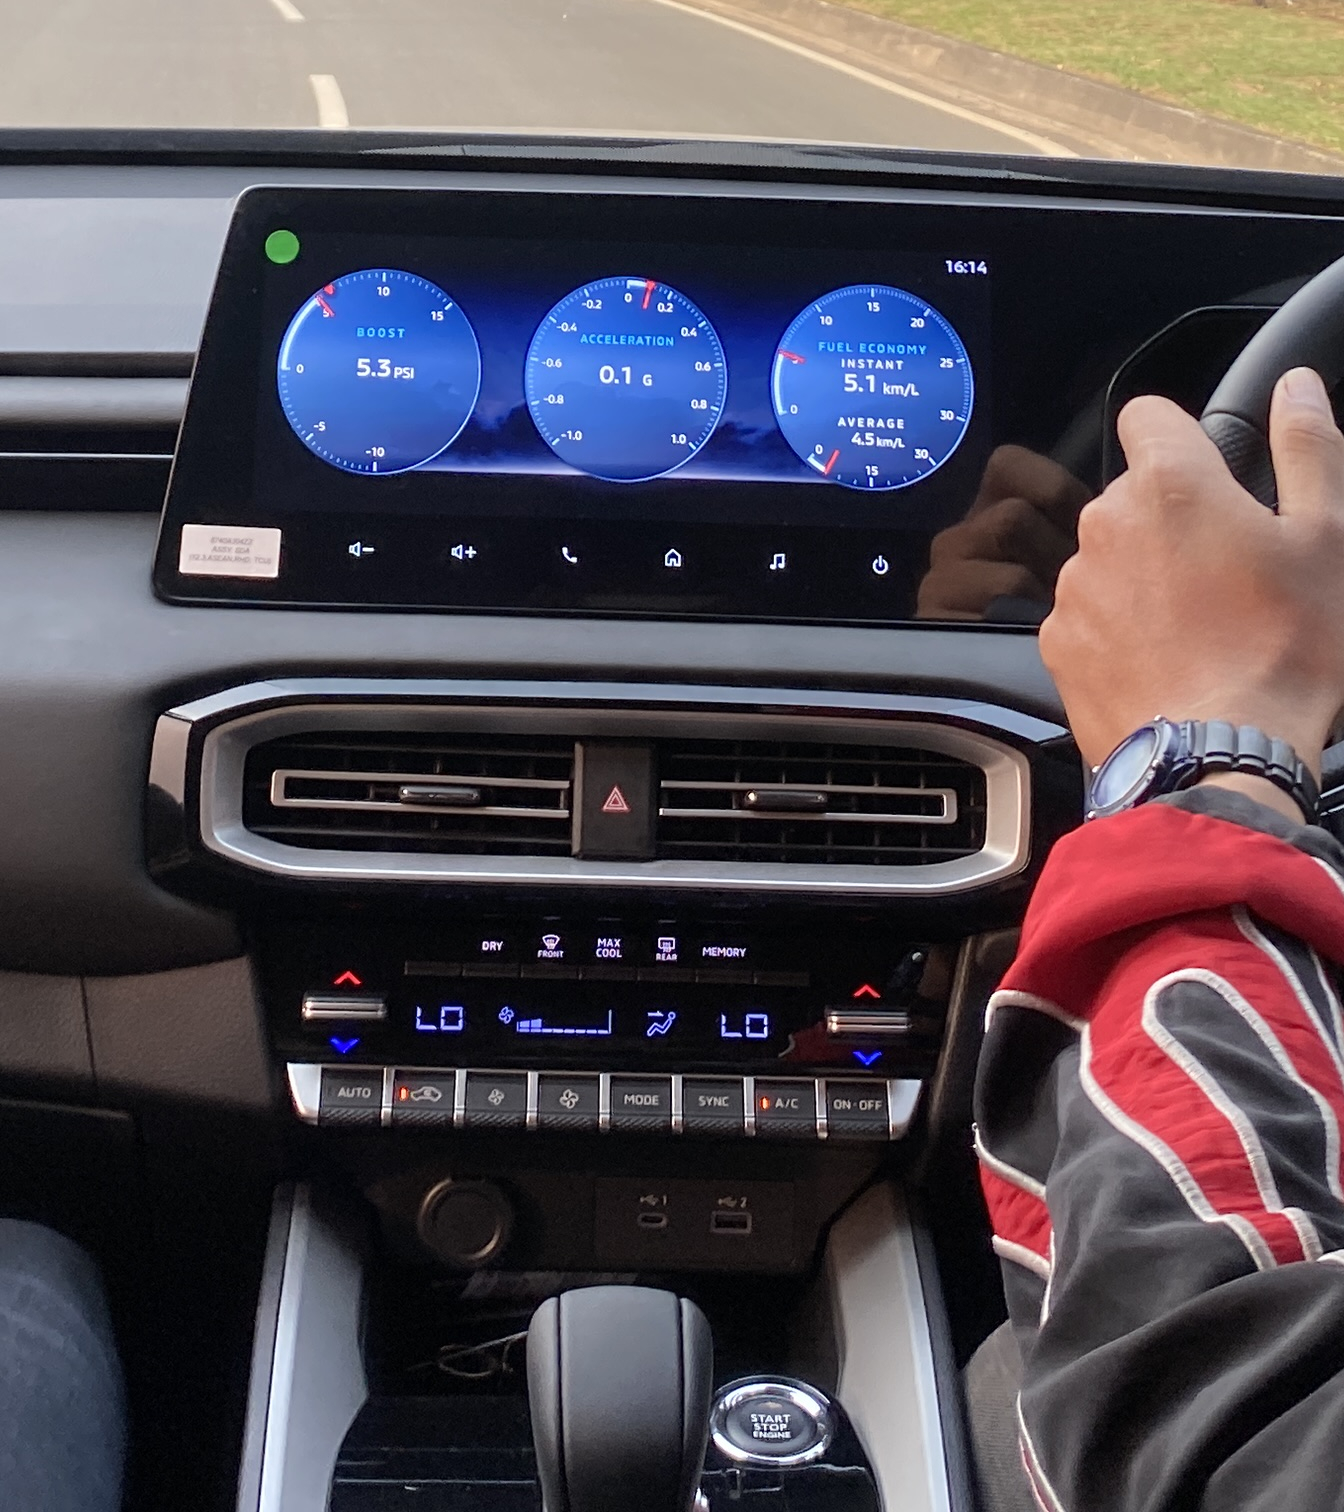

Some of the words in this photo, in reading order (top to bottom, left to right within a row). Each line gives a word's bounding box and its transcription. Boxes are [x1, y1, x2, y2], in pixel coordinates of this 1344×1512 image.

[945, 259, 988, 275] 16:14
[377, 286, 390, 296] 10
[624, 293, 632, 303] 0
[582, 300, 602, 309] -0.2
[657, 303, 674, 313] 0.2
[867, 302, 880, 312] 15
[430, 310, 444, 321] 15
[819, 316, 833, 325] 10
[557, 322, 577, 332] -0.4
[910, 318, 925, 328] 20
[356, 327, 406, 338] BOOST
[680, 327, 698, 337] 0.4
[580, 334, 674, 347] ACCELERATION
[818, 341, 853, 352] FUEL
[859, 343, 927, 355] ECONOMY
[296, 363, 304, 373] 0
[541, 358, 562, 368] -0.6
[694, 362, 711, 371] 0.6
[841, 358, 905, 370] INSTANT
[939, 358, 954, 368] 25
[356, 358, 391, 377] 5.3
[393, 367, 414, 379] PSI
[599, 366, 632, 385] 0.1
[642, 374, 653, 386] G
[843, 373, 876, 393] 5.1
[883, 383, 920, 398] km/L
[543, 395, 564, 404] -0.8
[690, 400, 707, 409] 0.8
[790, 405, 798, 414] 0
[939, 410, 954, 420] 30
[313, 421, 326, 431] -5
[837, 417, 905, 429] AVERAGE
[561, 430, 583, 441] -1.0
[671, 434, 687, 444] 1.0
[851, 433, 875, 446] 4.5
[876, 436, 906, 449] km/L
[365, 447, 385, 457] -10
[815, 445, 823, 454] 0
[914, 449, 929, 459] 30
[866, 466, 879, 476] 15
[482, 941, 503, 952] DRY
[598, 938, 620, 948] MAX
[538, 950, 564, 958] FRONT
[596, 948, 622, 958] COOL
[656, 953, 678, 961] REAR
[702, 947, 746, 958] MEMORY
[338, 1087, 371, 1098] AUTO
[624, 1094, 659, 1107] MODE
[698, 1095, 729, 1107] SYNC
[775, 1097, 799, 1109] A/C
[751, 1413, 791, 1423] START
[754, 1423, 787, 1431] STOP
